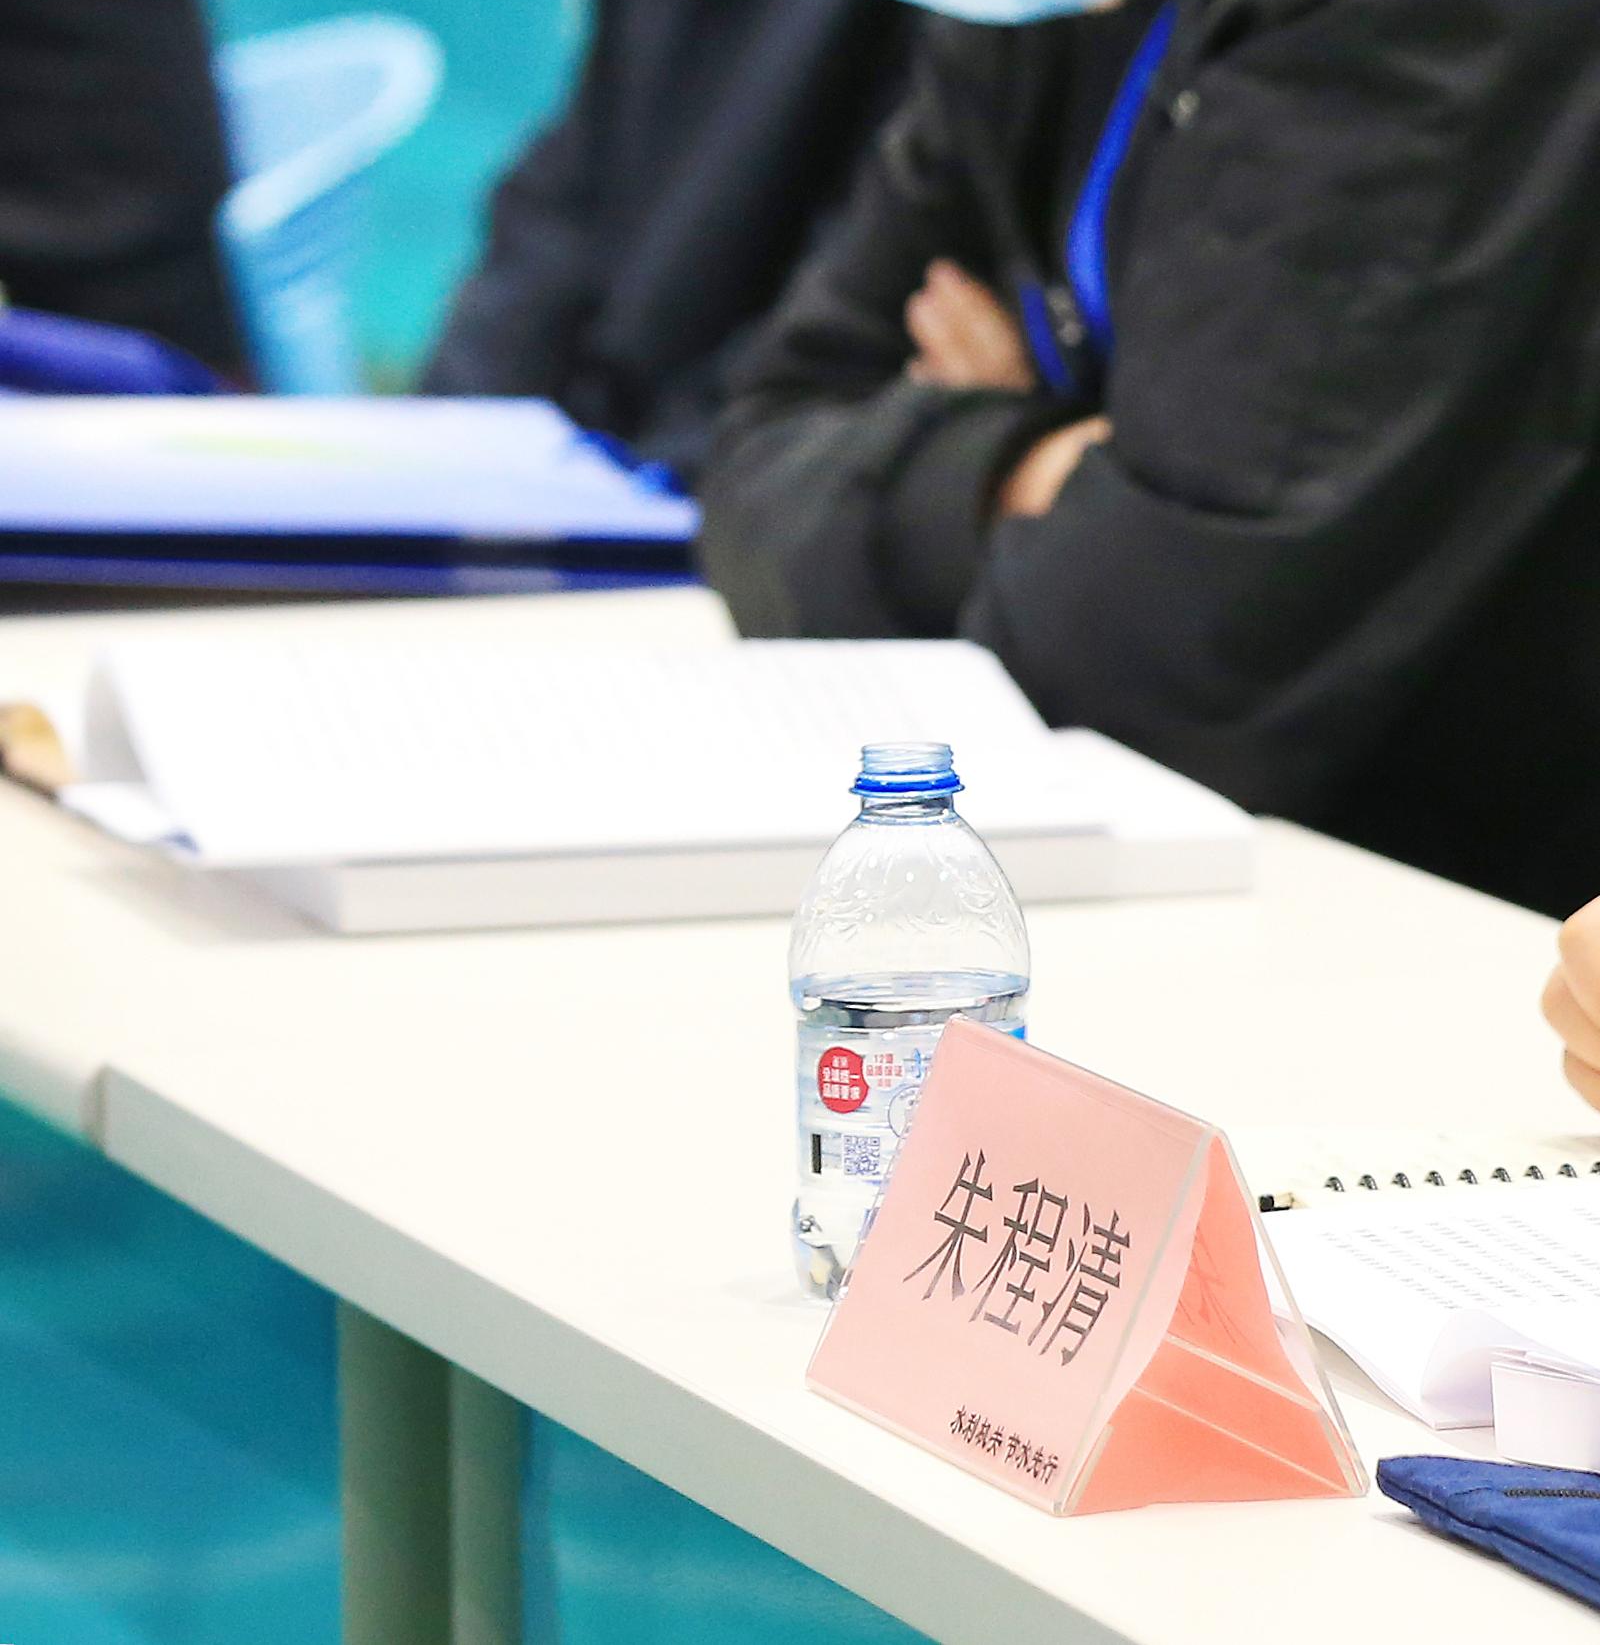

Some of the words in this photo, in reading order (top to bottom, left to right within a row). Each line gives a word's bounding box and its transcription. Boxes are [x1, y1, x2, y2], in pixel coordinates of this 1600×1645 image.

[902, 1149, 1130, 1366] 朱程清
[949, 1404, 1005, 1457] 水利机关
[1004, 1432, 1059, 1485] 节水先行
